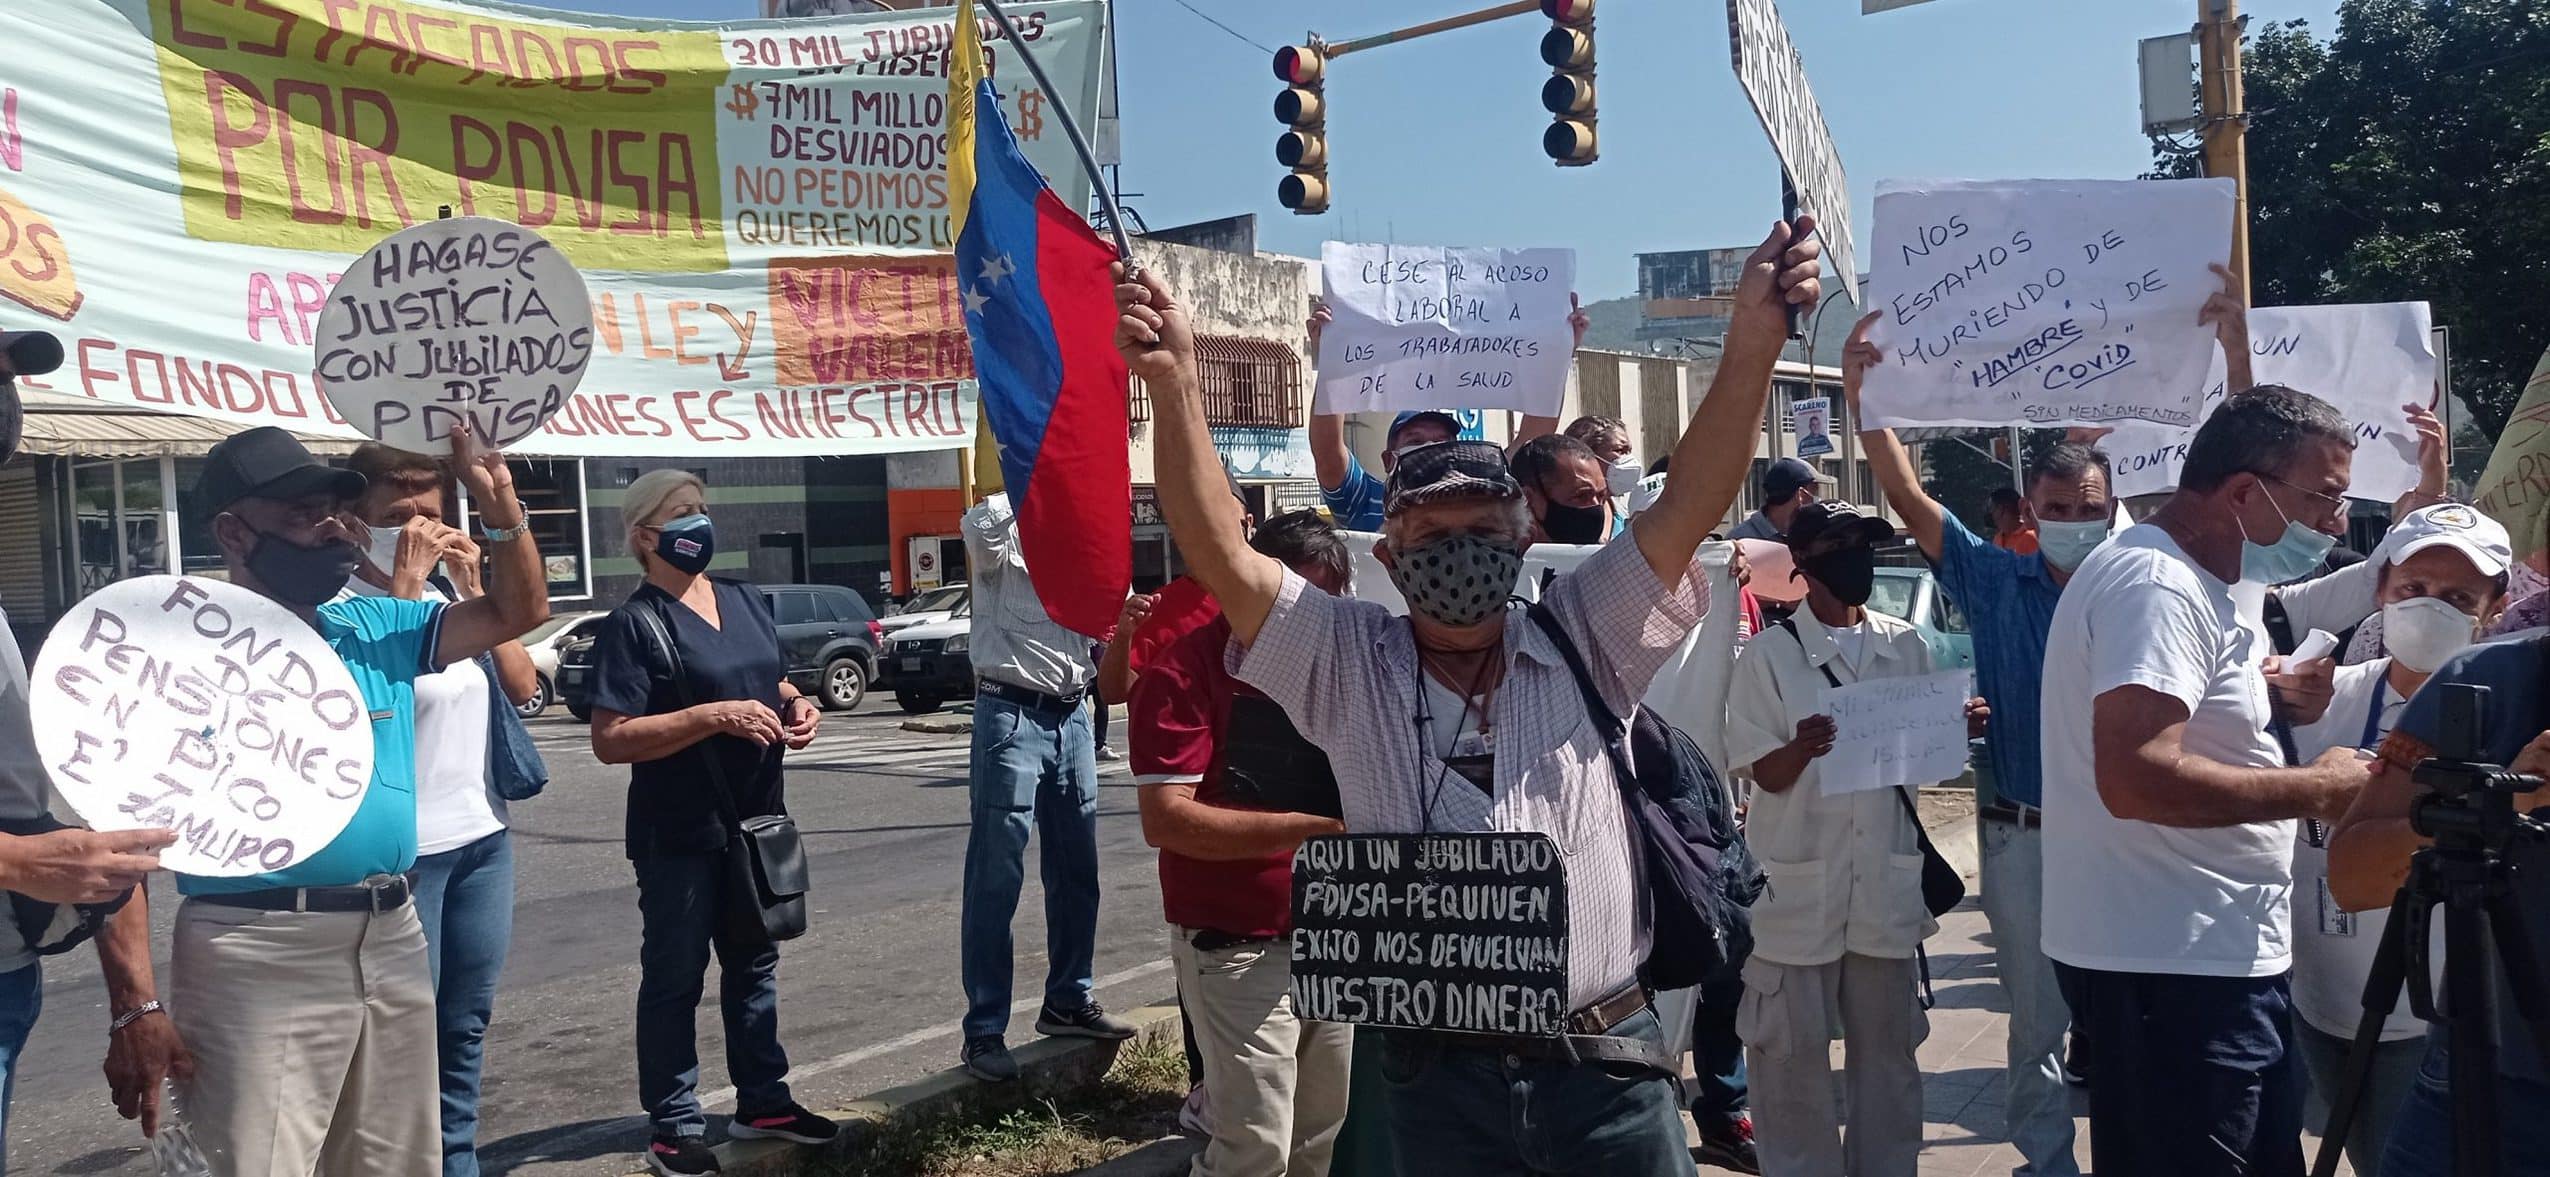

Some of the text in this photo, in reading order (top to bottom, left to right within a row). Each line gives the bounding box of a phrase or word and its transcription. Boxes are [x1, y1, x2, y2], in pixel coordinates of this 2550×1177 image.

[731, 38, 781, 67] 30
[790, 34, 855, 66] MIL
[204, 70, 416, 229] POR
[450, 114, 706, 240] PDVSA
[735, 165, 948, 210] NO PEDIMOS
[735, 208, 922, 248] QUEREMOS
[1902, 215, 1969, 266] NOS
[2083, 228, 2125, 265] DE
[373, 232, 551, 289] HAGASE
[1362, 257, 1549, 285] CESE AL ACOSO
[1892, 230, 2033, 326] ESTAMOS
[780, 267, 966, 330] VICTI
[2124, 268, 2169, 302] DE
[1395, 294, 1521, 323] LABORAL A
[634, 293, 757, 374] LEY
[1344, 343, 1375, 364] LOS
[2253, 334, 2300, 356] UN
[318, 348, 397, 383] CON
[1360, 370, 1514, 395] DE LA SALUD
[78, 338, 309, 418] FONDO
[673, 390, 751, 441] ES
[755, 382, 967, 440] NUESTRO
[436, 377, 510, 402] DE
[373, 384, 562, 449] PDVSA
[2118, 443, 2188, 476] CONTR
[160, 579, 359, 731] FONDO
[55, 664, 140, 732] EN
[79, 607, 362, 800] PENSIONES
[1291, 838, 1551, 875] AQUI UN JUBILADO
[1292, 929, 1564, 973] EXIJO NOS DEVUELVAN
[1291, 974, 1562, 1036] NUESTRO DINERO
